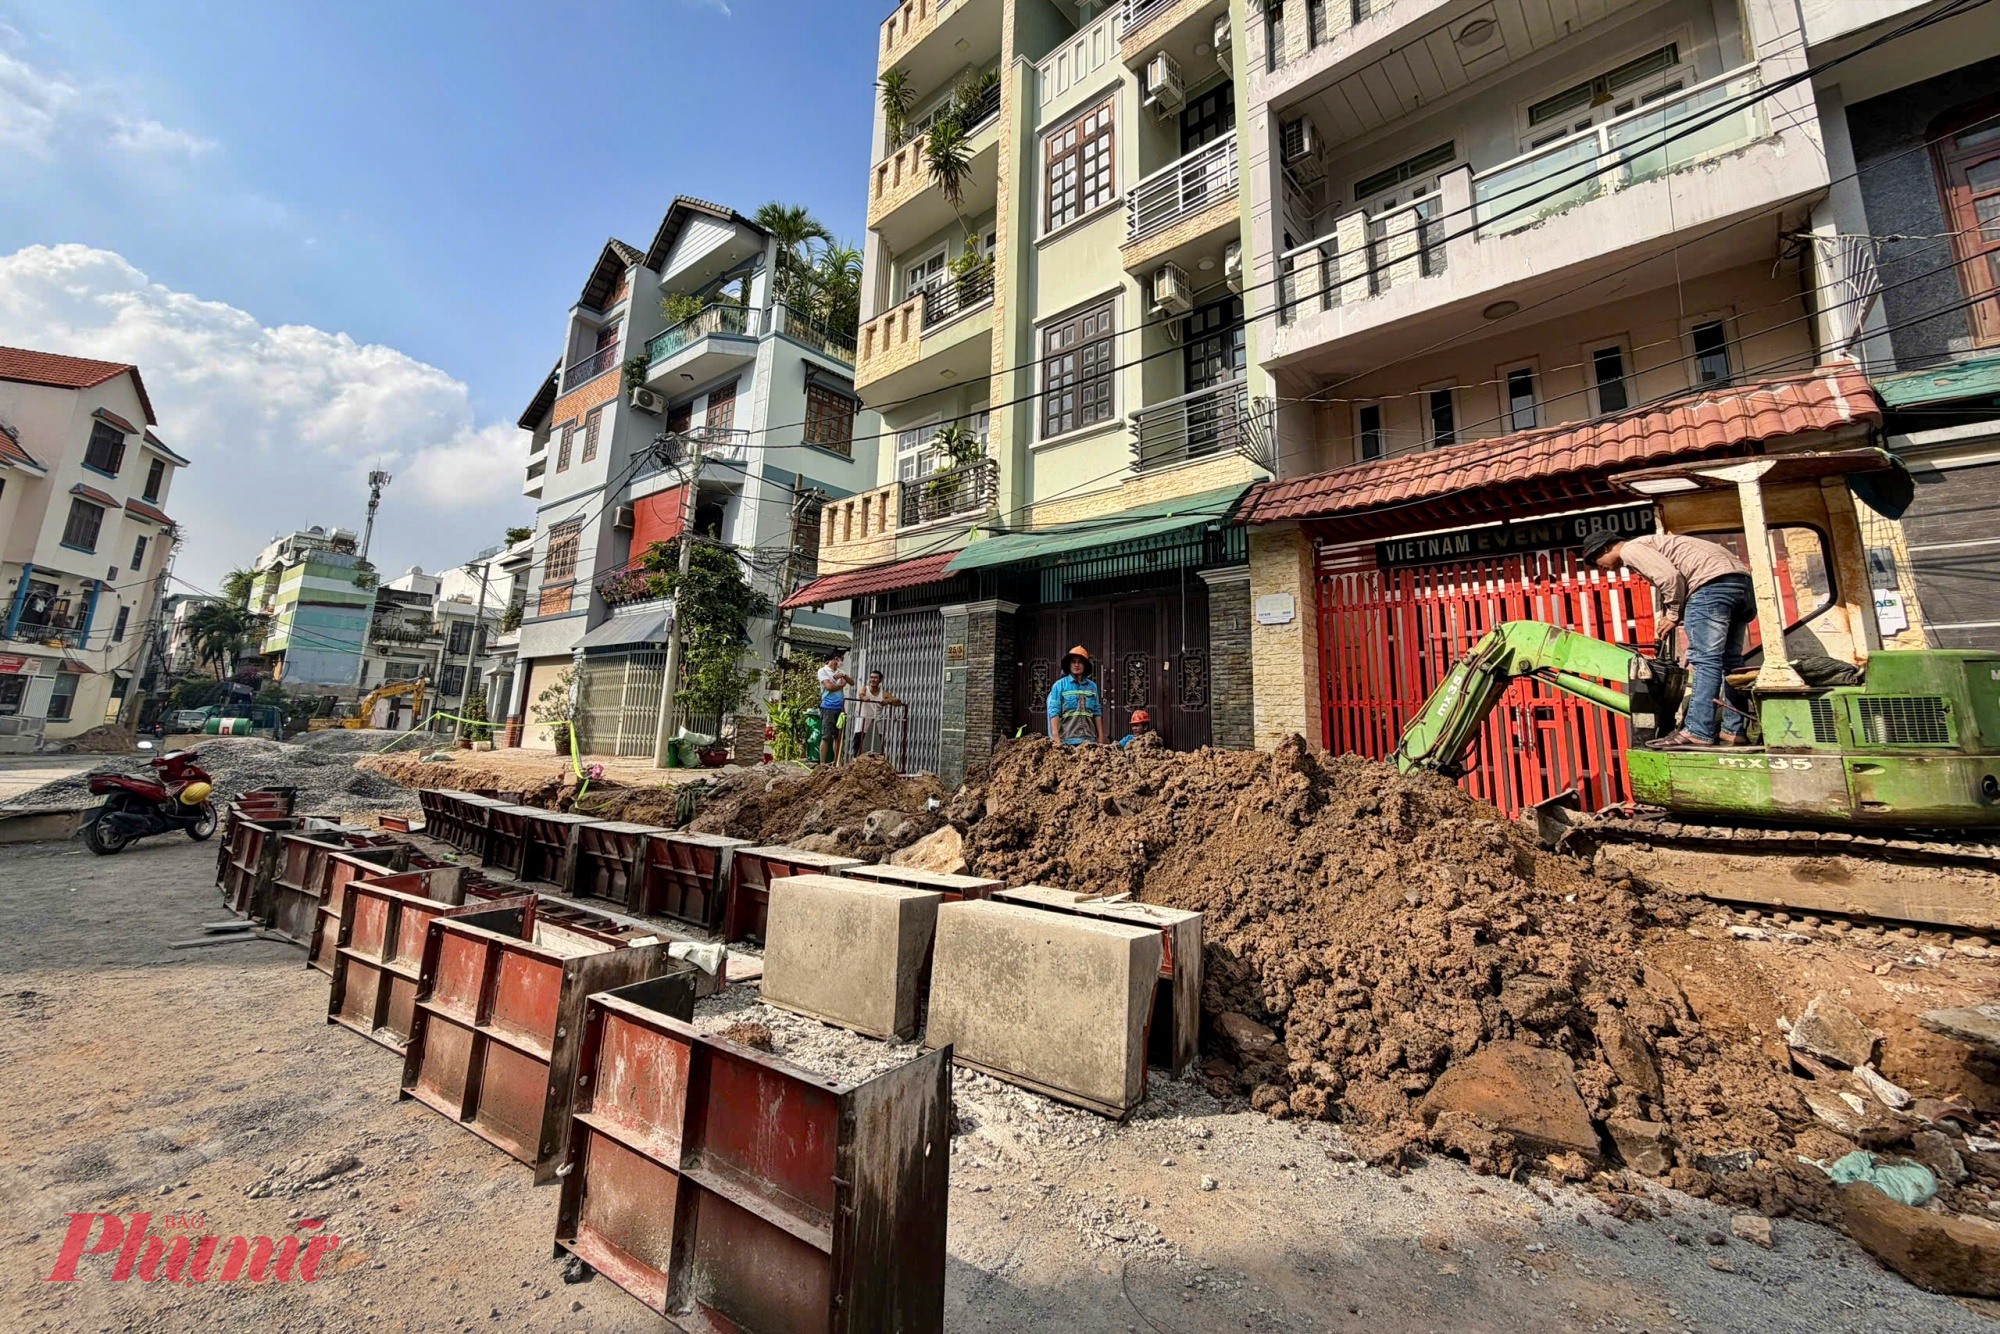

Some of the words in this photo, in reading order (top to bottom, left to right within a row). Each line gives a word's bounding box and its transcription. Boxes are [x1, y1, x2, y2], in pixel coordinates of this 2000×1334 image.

[1385, 534, 1470, 562] VIETNAM
[1477, 522, 1563, 550] EVENT
[1575, 509, 1653, 538] GROUP
